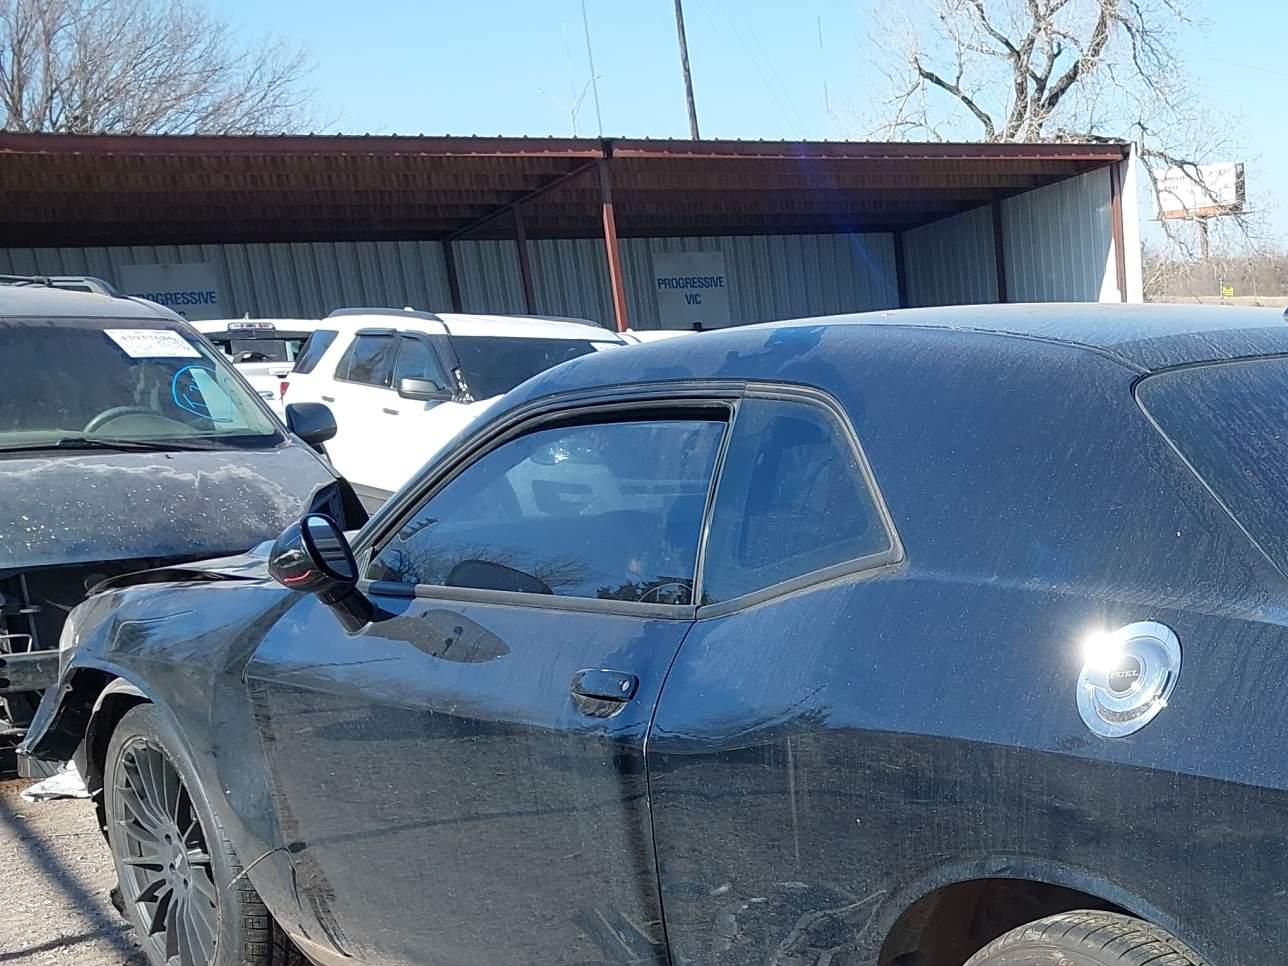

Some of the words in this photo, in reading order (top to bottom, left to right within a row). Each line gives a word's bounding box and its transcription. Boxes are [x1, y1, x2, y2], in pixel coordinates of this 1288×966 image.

[657, 276, 725, 290] PROGRESSIVE
[127, 291, 218, 306] OGRESSIVE
[684, 293, 702, 305] VIC
[1110, 670, 1140, 679] FUEL
